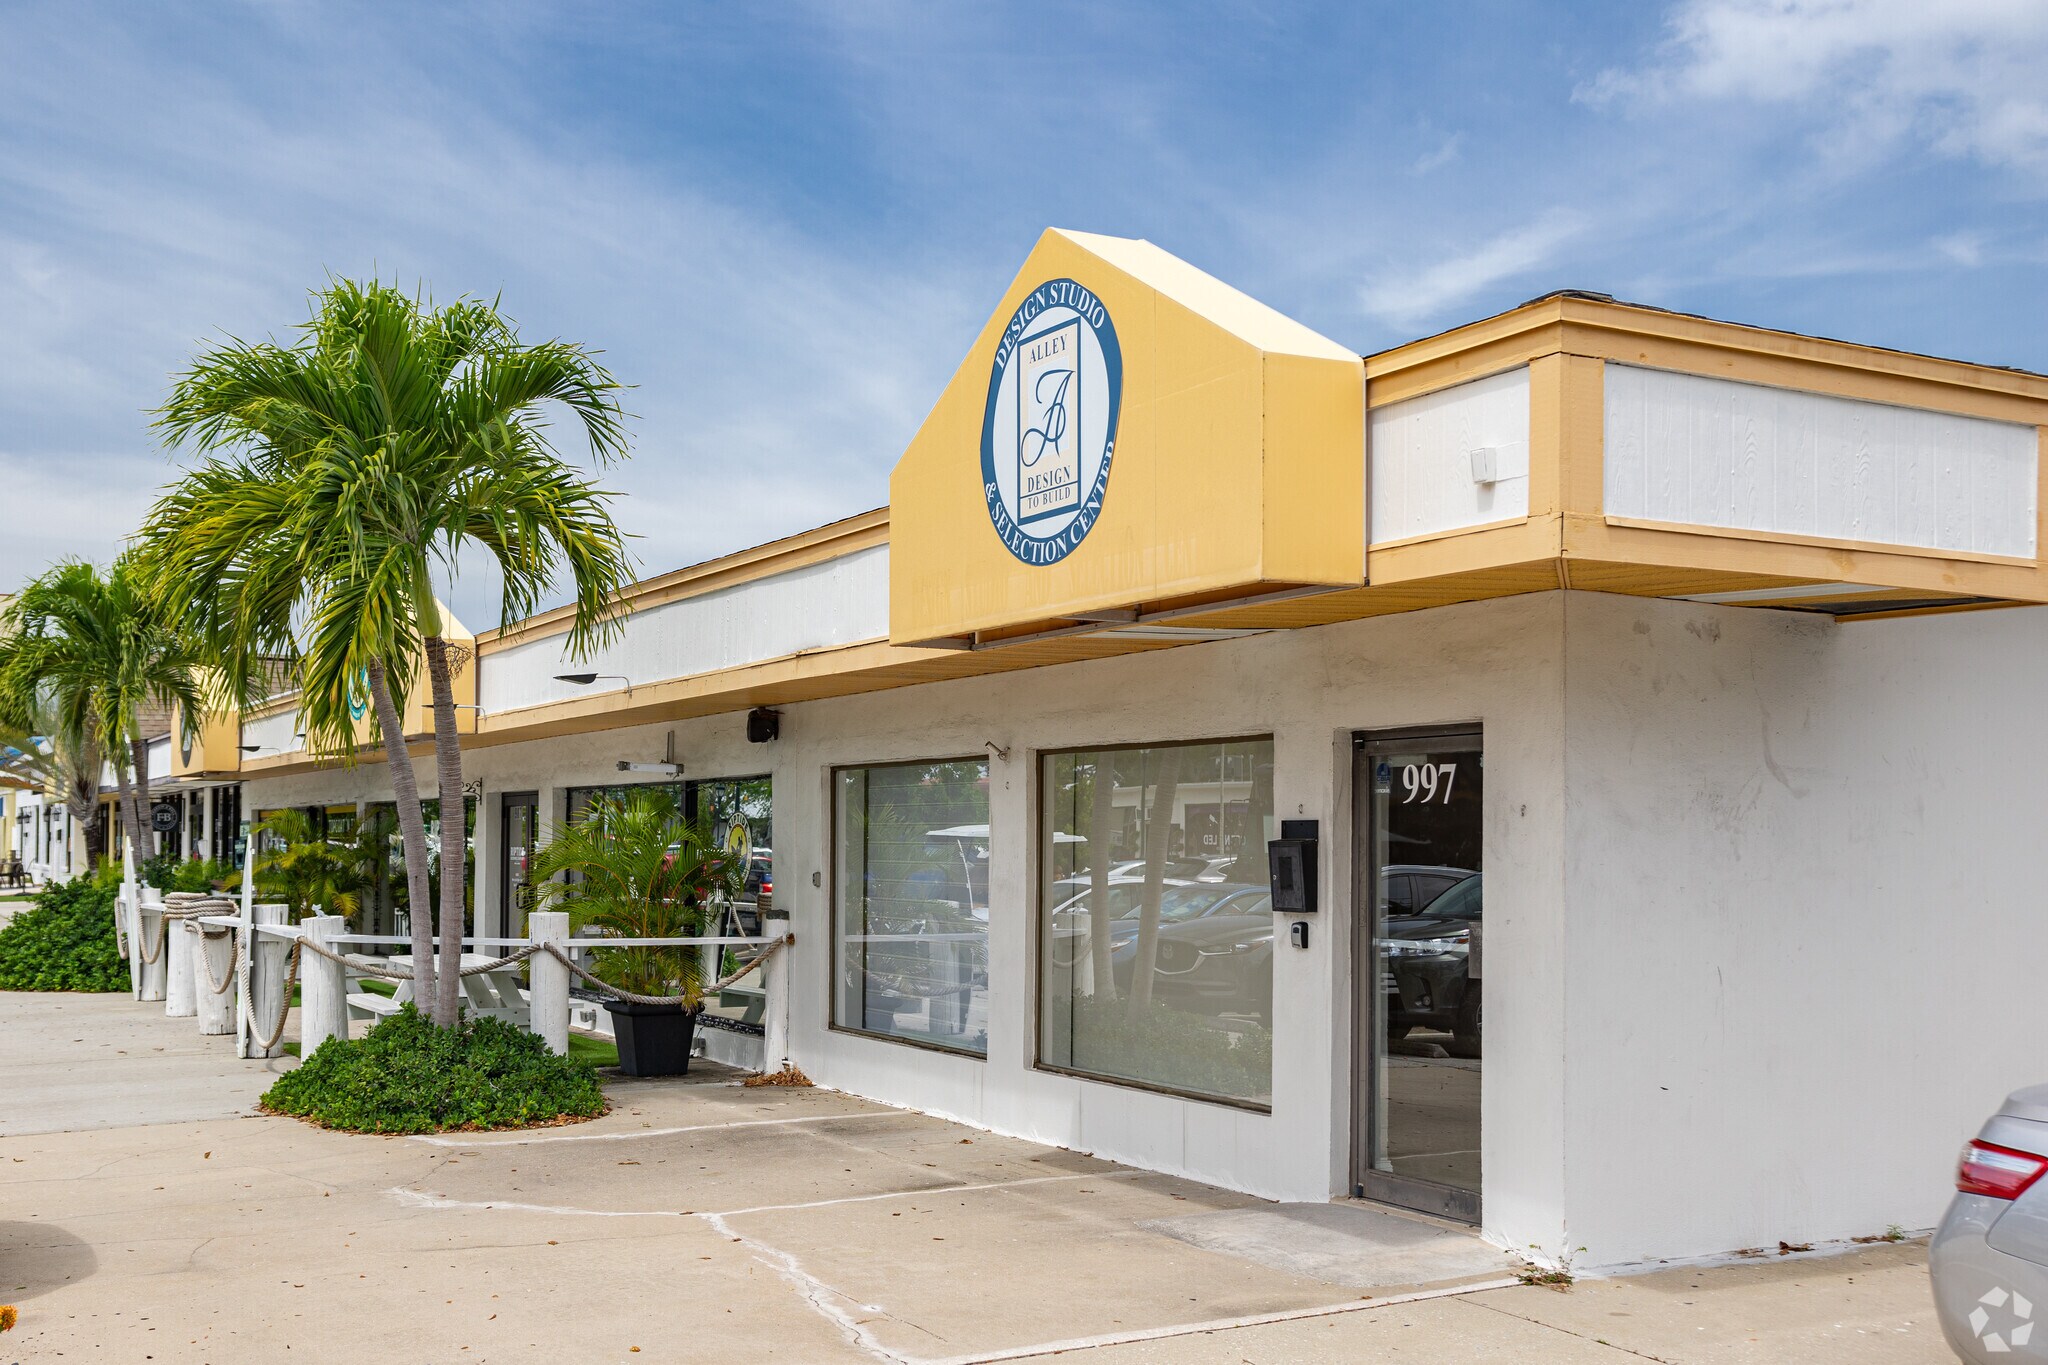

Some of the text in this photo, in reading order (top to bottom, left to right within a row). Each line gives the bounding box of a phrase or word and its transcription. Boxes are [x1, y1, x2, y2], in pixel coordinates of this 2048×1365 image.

[995, 282, 1105, 370] DESIGN STUDIO
[1029, 334, 1068, 364] ALLEY
[1027, 465, 1071, 493] DESIGN
[1028, 486, 1071, 509] TO BUILD
[985, 482, 996, 503] &
[991, 501, 1067, 563] SELECTION
[1402, 763, 1457, 805] 997
